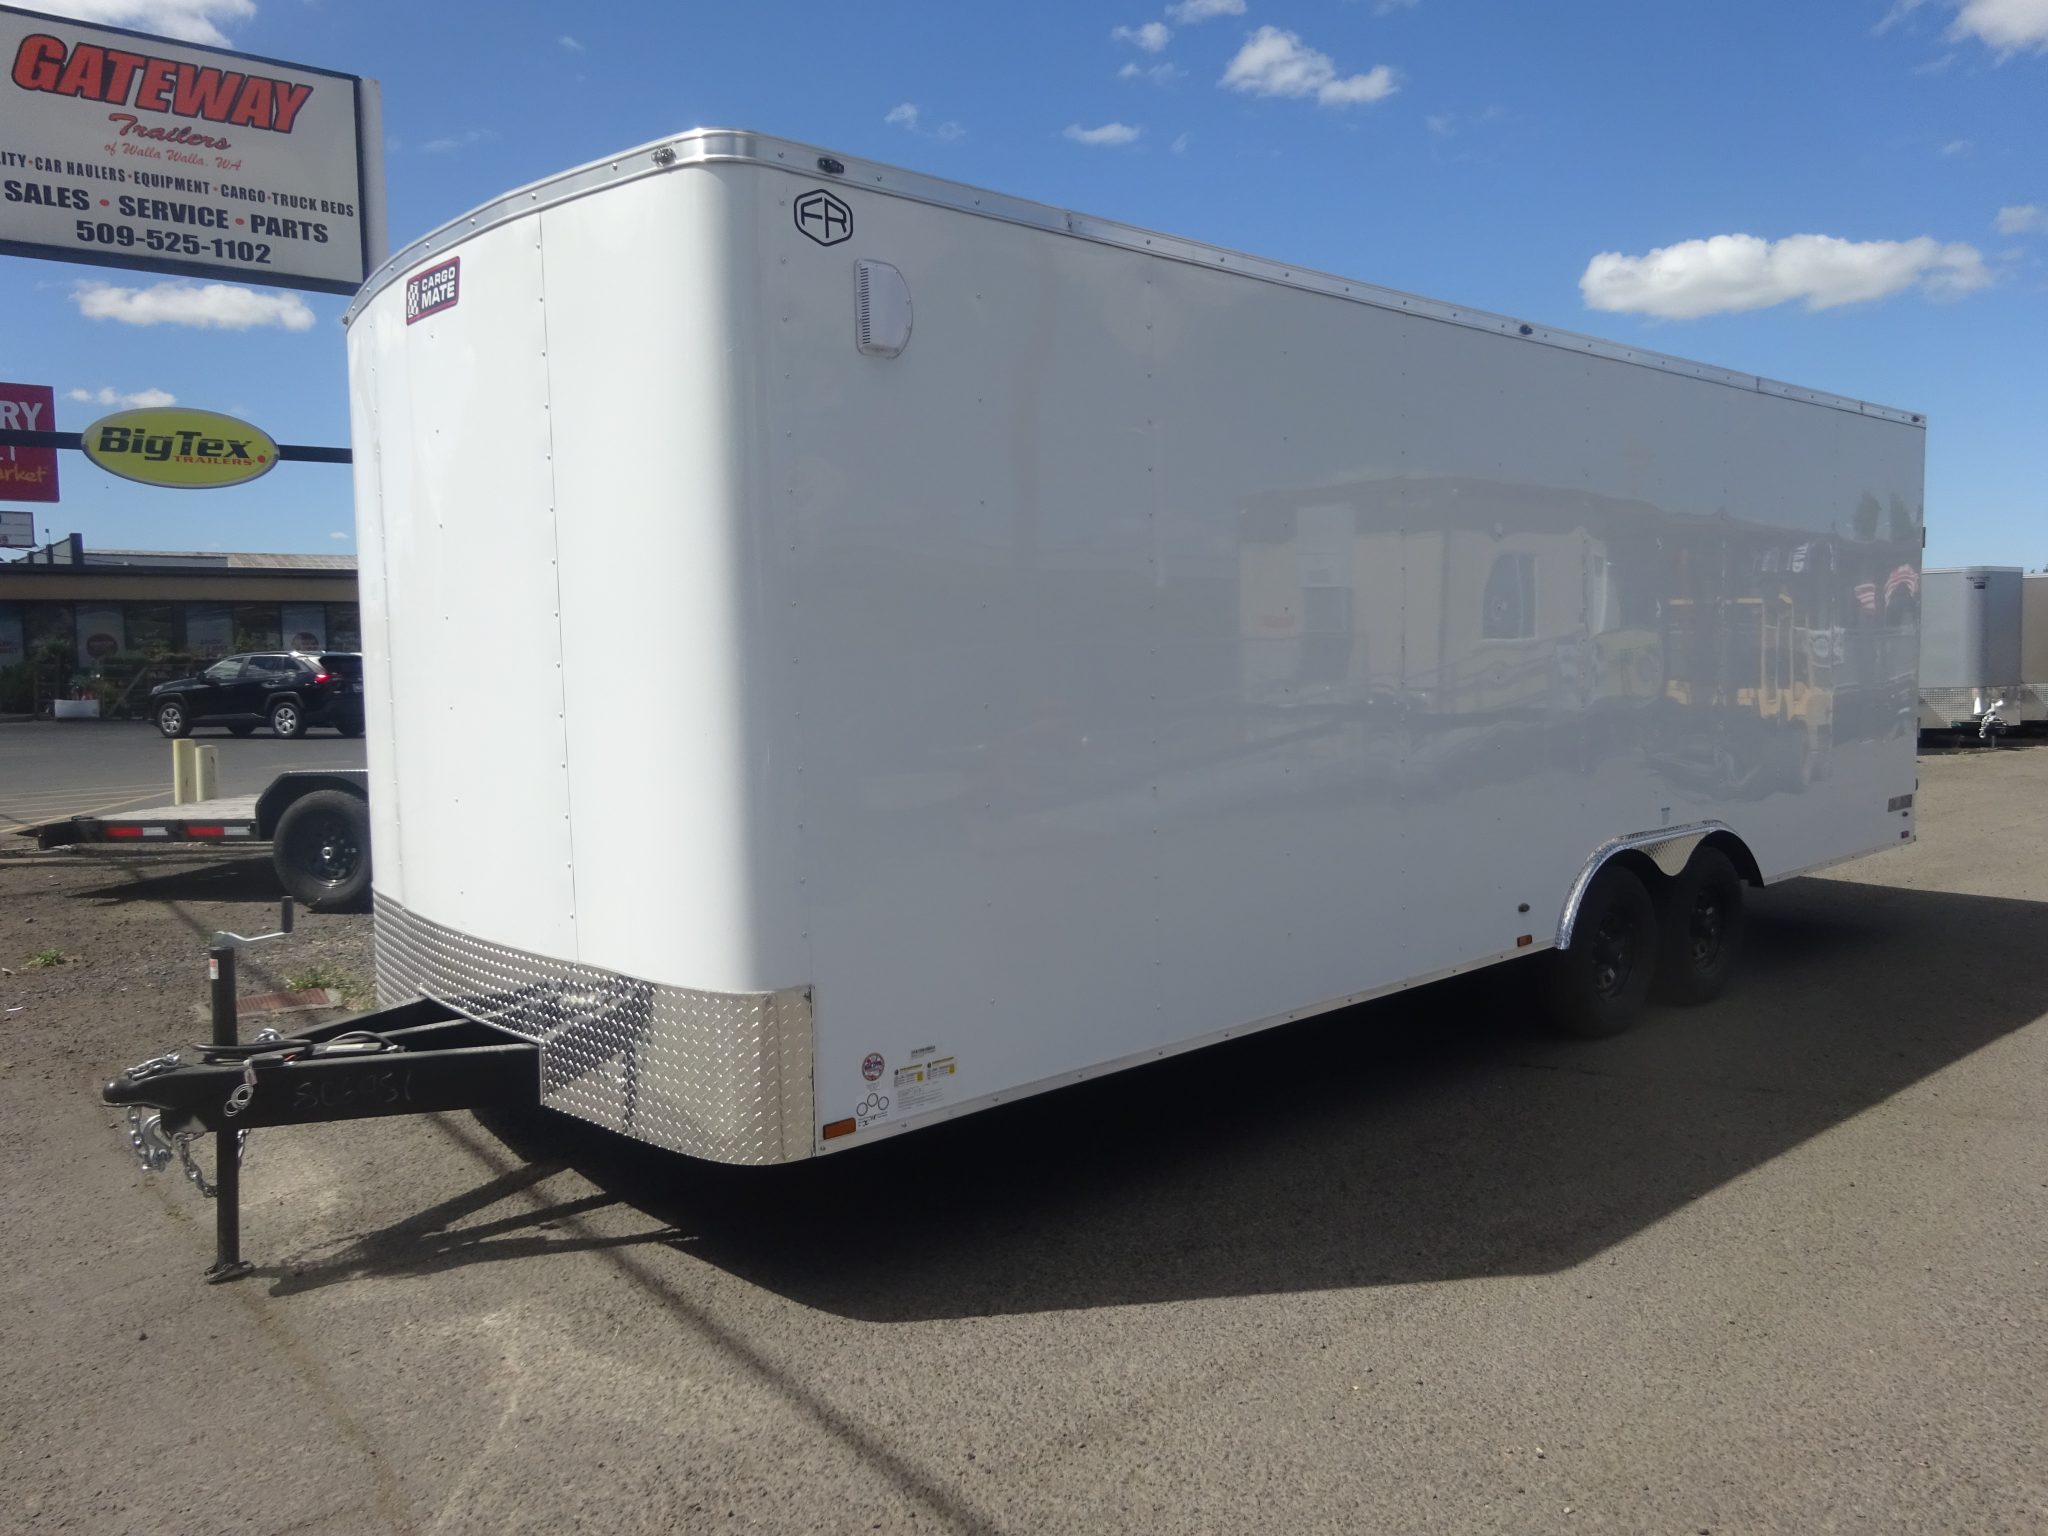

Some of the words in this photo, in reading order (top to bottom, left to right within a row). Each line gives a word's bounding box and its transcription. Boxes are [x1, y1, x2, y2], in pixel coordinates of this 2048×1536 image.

[11, 33, 313, 134] GATEWAY
[108, 112, 232, 150] Trailers
[104, 142, 117, 157] of
[121, 143, 161, 159] Walla
[215, 156, 242, 171] WA
[0, 151, 26, 168] ITY
[34, 156, 62, 173] CAR
[66, 161, 126, 182] HAULERS
[133, 171, 210, 195] EQUIPMENT
[220, 184, 266, 203] CARGO
[271, 192, 318, 211] TRUCK
[321, 201, 354, 217] BEDS
[4, 180, 90, 210] SALES
[118, 195, 229, 229] SERVICE
[250, 214, 329, 243] PARTS
[76, 220, 271, 264] 509-525-1102
[421, 266, 456, 292] CARGO
[421, 280, 455, 309] MATE
[174, 455, 254, 466] TRAILERS
